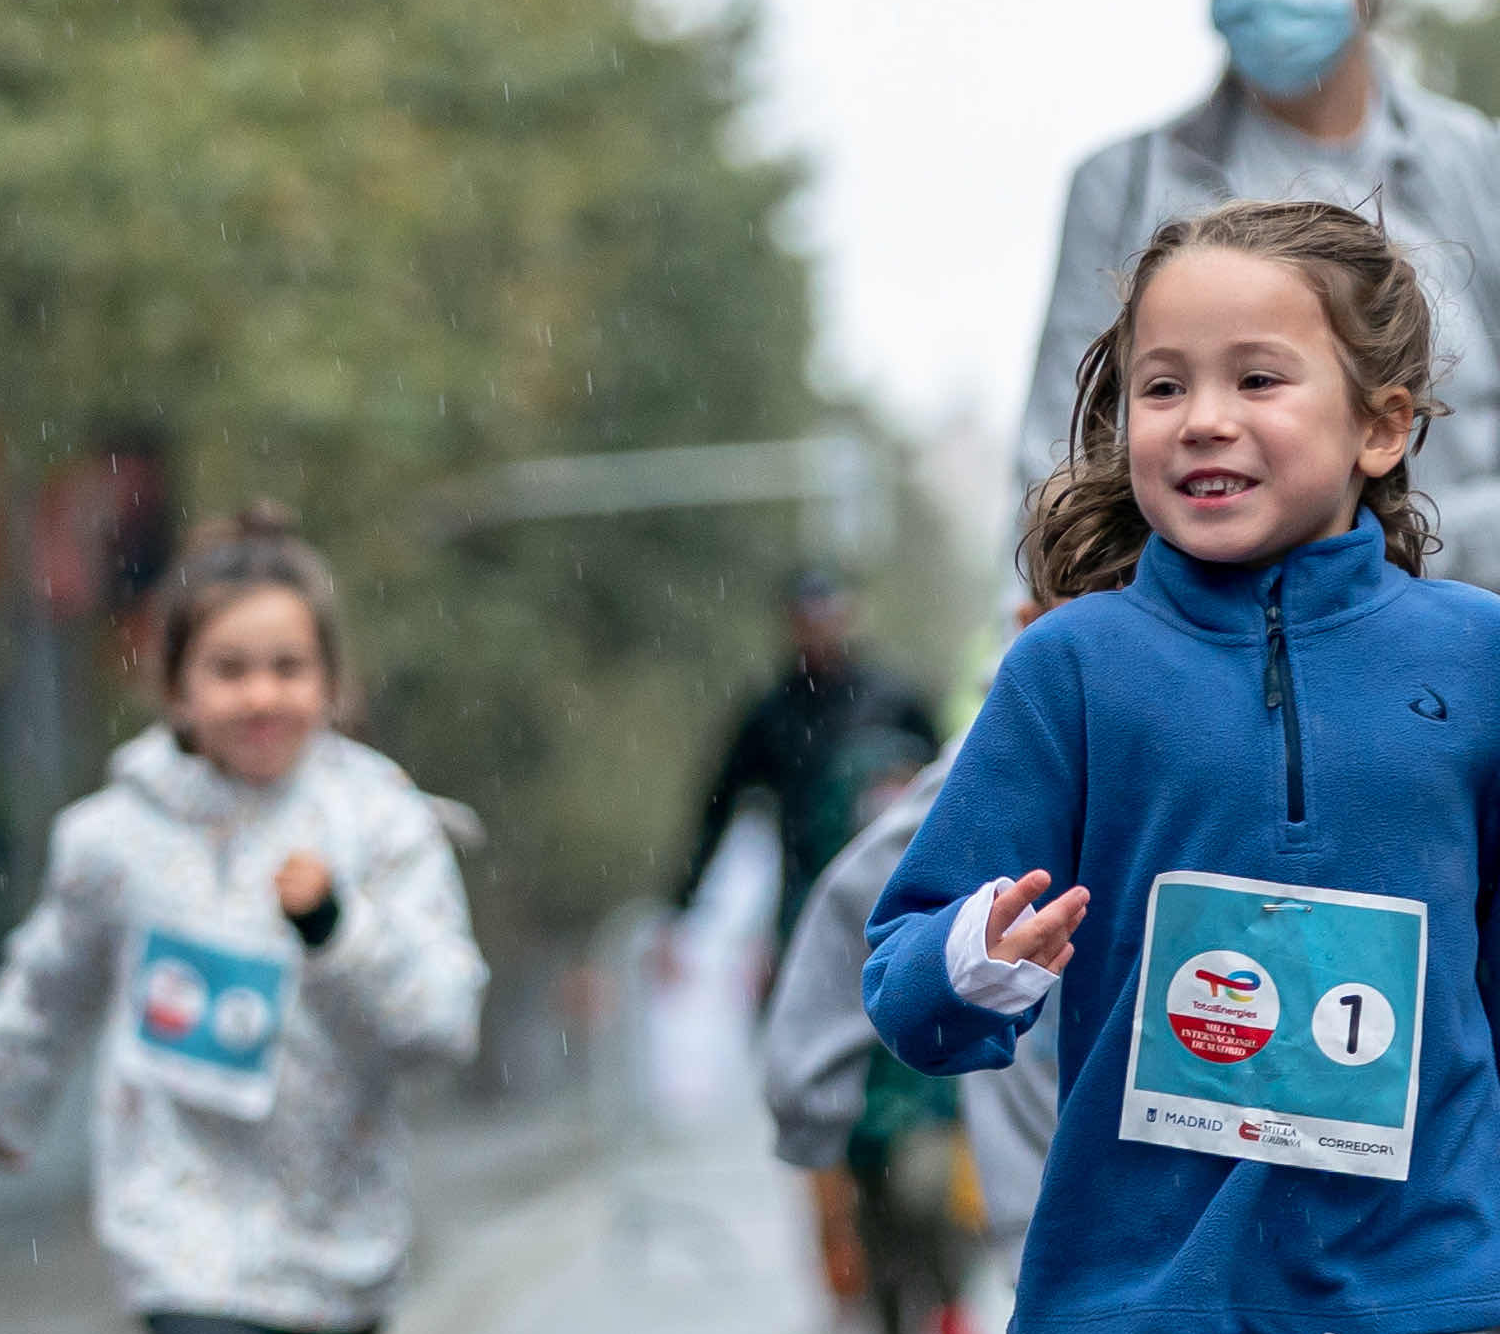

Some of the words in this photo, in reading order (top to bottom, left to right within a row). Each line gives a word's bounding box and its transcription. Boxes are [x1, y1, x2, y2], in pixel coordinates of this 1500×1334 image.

[1192, 1000, 1258, 1019] TotalEnergies
[1339, 994, 1362, 1055] 1
[1165, 1112, 1223, 1132] MADRID
